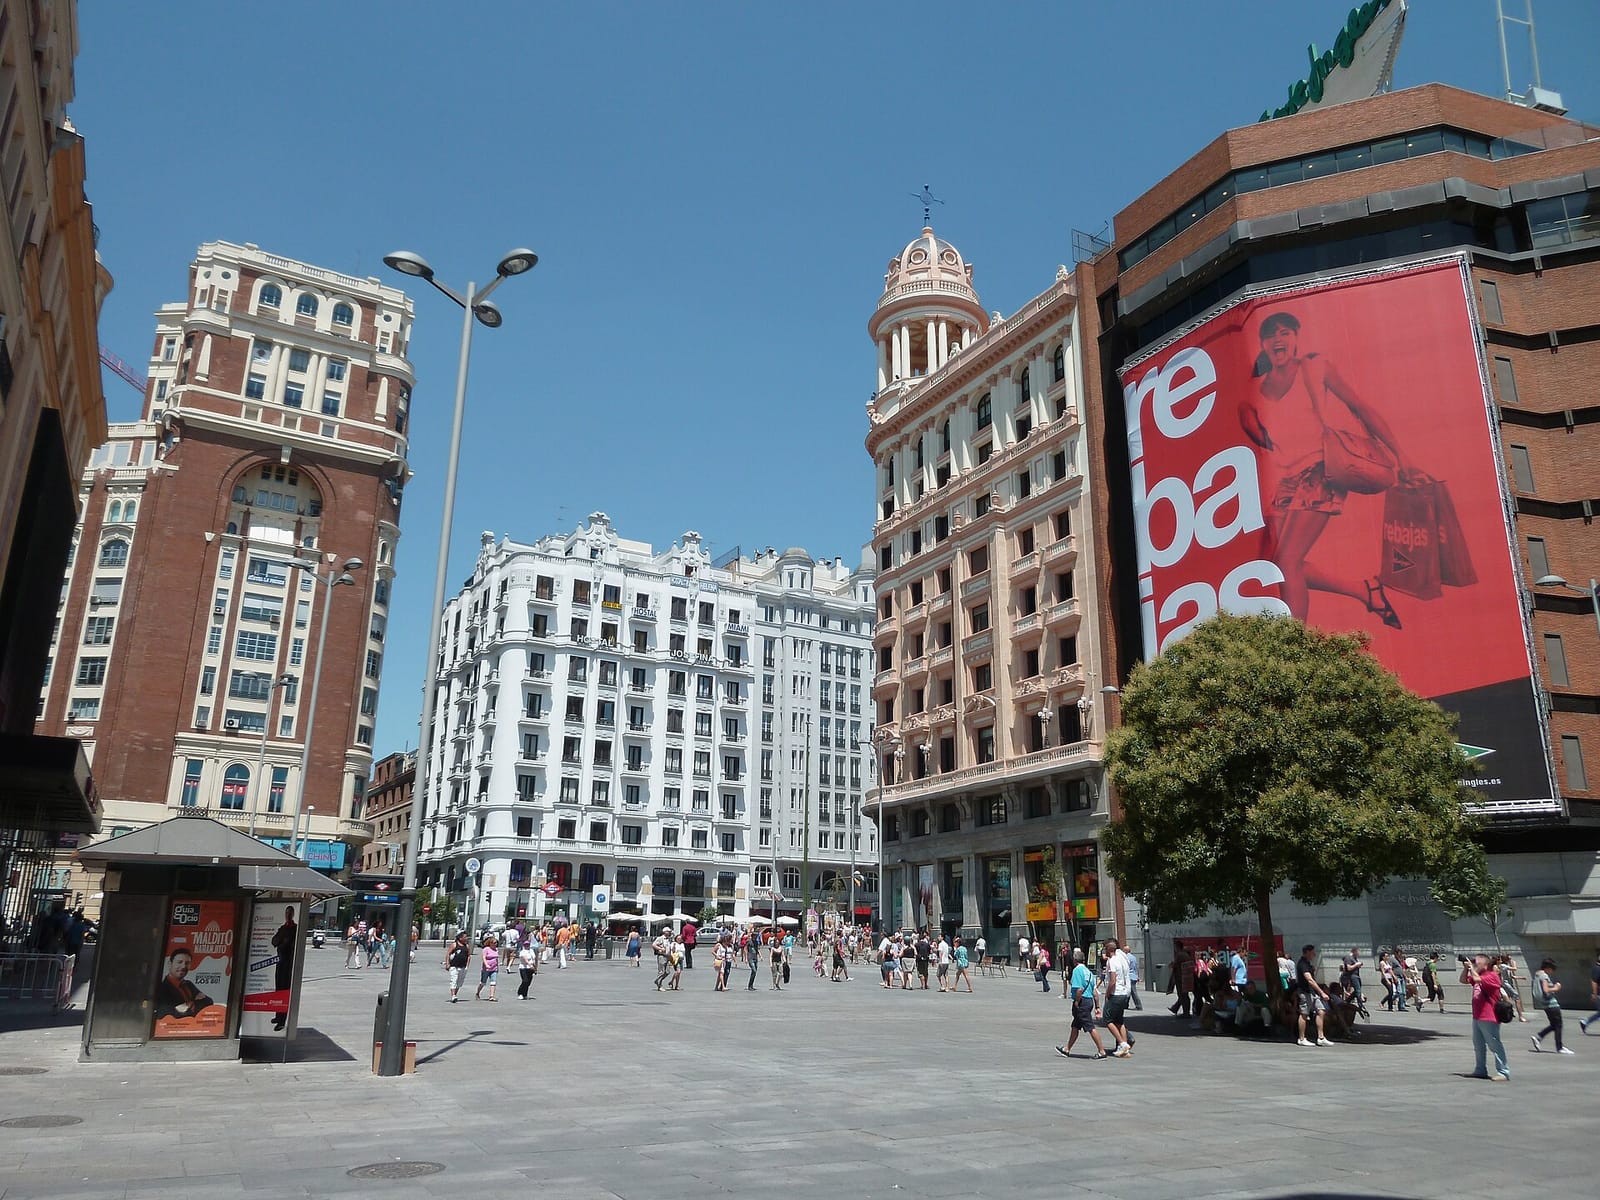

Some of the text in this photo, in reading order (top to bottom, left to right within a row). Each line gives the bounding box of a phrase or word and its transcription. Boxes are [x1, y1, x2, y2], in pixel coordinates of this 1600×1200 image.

[1123, 346, 1217, 464] re
[1131, 445, 1266, 573] ba
[1384, 521, 1429, 551] rebajas
[634, 608, 657, 617] HOSTAL
[728, 623, 750, 632] MIAMI
[1457, 778, 1501, 787] eingles.es
[307, 852, 337, 861] CHINO
[191, 929, 233, 946] MALDITO
